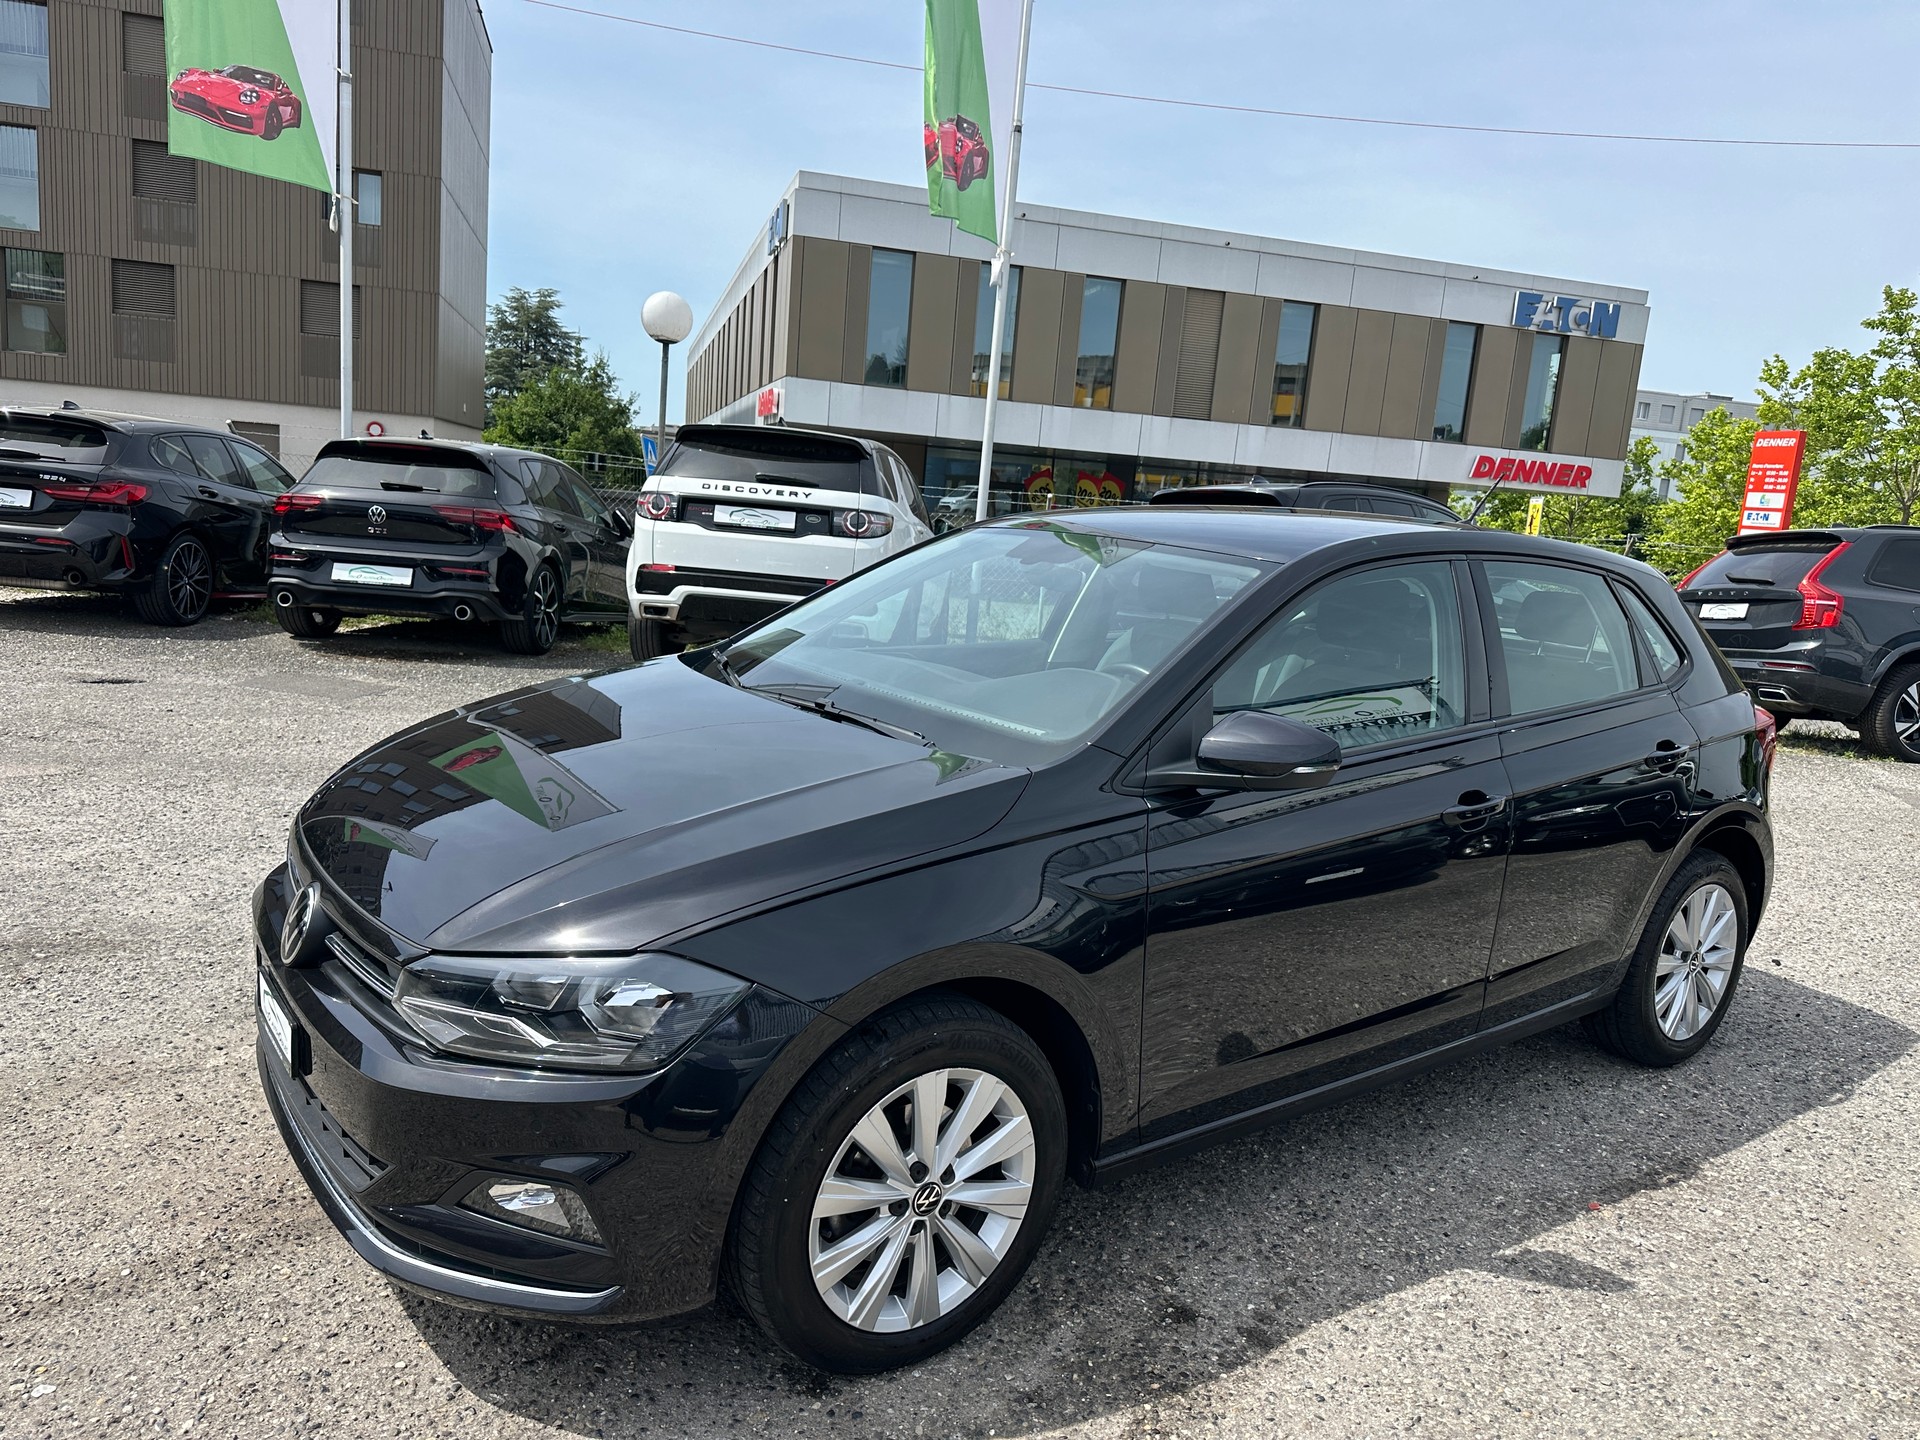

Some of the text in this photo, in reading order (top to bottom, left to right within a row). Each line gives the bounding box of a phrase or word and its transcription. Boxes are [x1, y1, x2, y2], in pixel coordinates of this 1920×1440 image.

[1512, 291, 1621, 338] EATON
[1756, 438, 1796, 447] DENNER
[1470, 455, 1592, 488] DENNER
[702, 483, 812, 498] DISCOVERY
